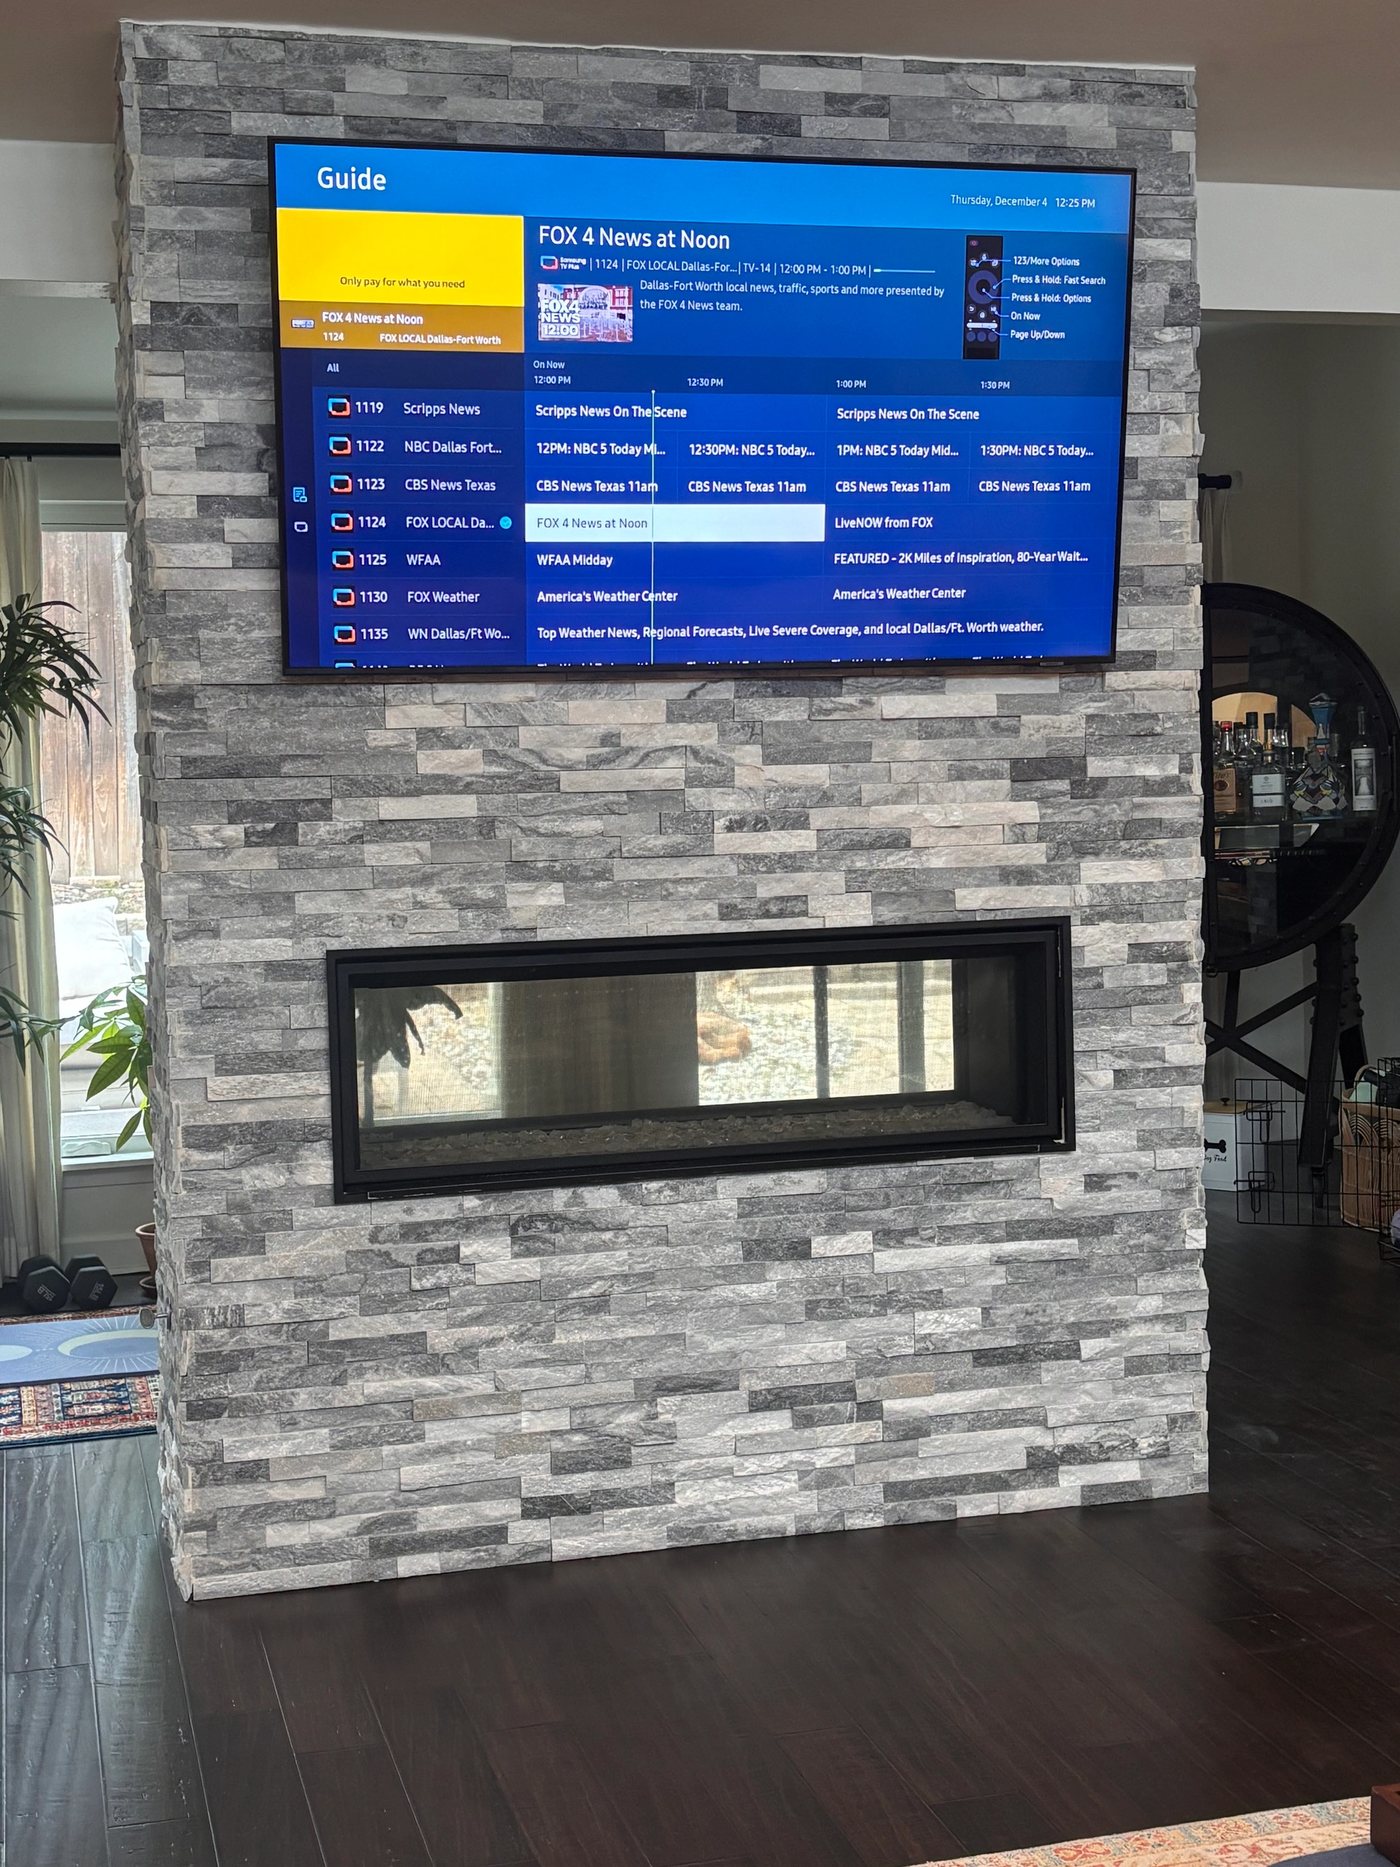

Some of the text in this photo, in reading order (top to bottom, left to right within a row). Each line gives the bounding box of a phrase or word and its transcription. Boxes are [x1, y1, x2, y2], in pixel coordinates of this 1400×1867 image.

[318, 167, 386, 190] Guide
[951, 195, 1047, 207] Thursday, December 4
[1056, 198, 1095, 207] 12:25 PM
[540, 226, 729, 249] FOX 4 News at Noon
[560, 257, 586, 266] Samsung
[596, 259, 618, 269] 1124
[627, 260, 646, 269] FOX
[649, 261, 680, 271] LOCAL
[743, 263, 770, 272] TV-14
[780, 264, 804, 273] 12:00
[807, 265, 821, 273] PM
[831, 265, 850, 274] 1:00
[852, 266, 866, 275] PM
[1014, 256, 1080, 267] 123/More Options
[340, 277, 361, 287] Only
[364, 279, 380, 287] pay
[383, 278, 396, 286] for
[398, 279, 421, 287] what
[423, 281, 440, 289] you
[1013, 275, 1105, 284] Press & Hold: Fast Search
[641, 280, 944, 298] Dallas-Fort Worth local news, traffic, sports and more presented by
[640, 299, 742, 311] the FOX 4 News team.
[542, 314, 581, 323] NEWS
[1011, 312, 1040, 320] On Now
[542, 325, 579, 336] 12:00
[1011, 330, 1065, 340] Page Up/Down
[327, 363, 339, 372] All
[533, 360, 545, 368] On
[535, 376, 570, 384] 12:00 PM
[981, 381, 996, 389] 1:30
[356, 402, 383, 413] 1119
[404, 403, 480, 417] Scripps News
[536, 405, 687, 419] Scripps News On The Scene
[357, 440, 384, 451] 1122
[405, 441, 429, 452] NBC
[433, 441, 467, 452] Dallas
[537, 443, 571, 454] 12PM:
[574, 443, 598, 454] NBC
[601, 443, 607, 454] 5
[610, 443, 642, 457] Today
[981, 445, 1021, 455] 1:30PM:
[1024, 445, 1046, 456] NBC
[1049, 445, 1054, 455] 5
[358, 478, 385, 490] 1123
[405, 479, 496, 490] CBS News Texas
[537, 480, 658, 493] CBS News Texas 11am
[979, 481, 1090, 491] CBS News Texas 11am
[359, 516, 386, 527] 1124
[407, 517, 429, 528] FOX
[432, 517, 469, 528] LOCAL
[538, 518, 647, 528] FOX 4 News at Noon
[835, 517, 933, 528] LiveNOW from FOX
[359, 554, 386, 565] 1125
[407, 554, 441, 565] WFAA
[537, 554, 613, 567] WFAA Midday
[834, 553, 889, 564] FEATURED
[899, 553, 912, 563] 2K
[914, 552, 942, 563] Miles
[944, 552, 955, 563] of
[957, 552, 1014, 565] Inspiration,
[1017, 552, 1056, 562] 80-Year
[360, 591, 387, 602] 1130
[408, 591, 480, 602] FOX Weather
[537, 591, 678, 603] America's Weather Center
[361, 629, 388, 639] 1135
[408, 629, 427, 639] WN
[431, 628, 482, 639] Dallas/Ft
[537, 621, 1043, 641] Top Weather News, Regional Forecasts, Live Severe Coverage, and local Dallas/Ft. Worth weather.
